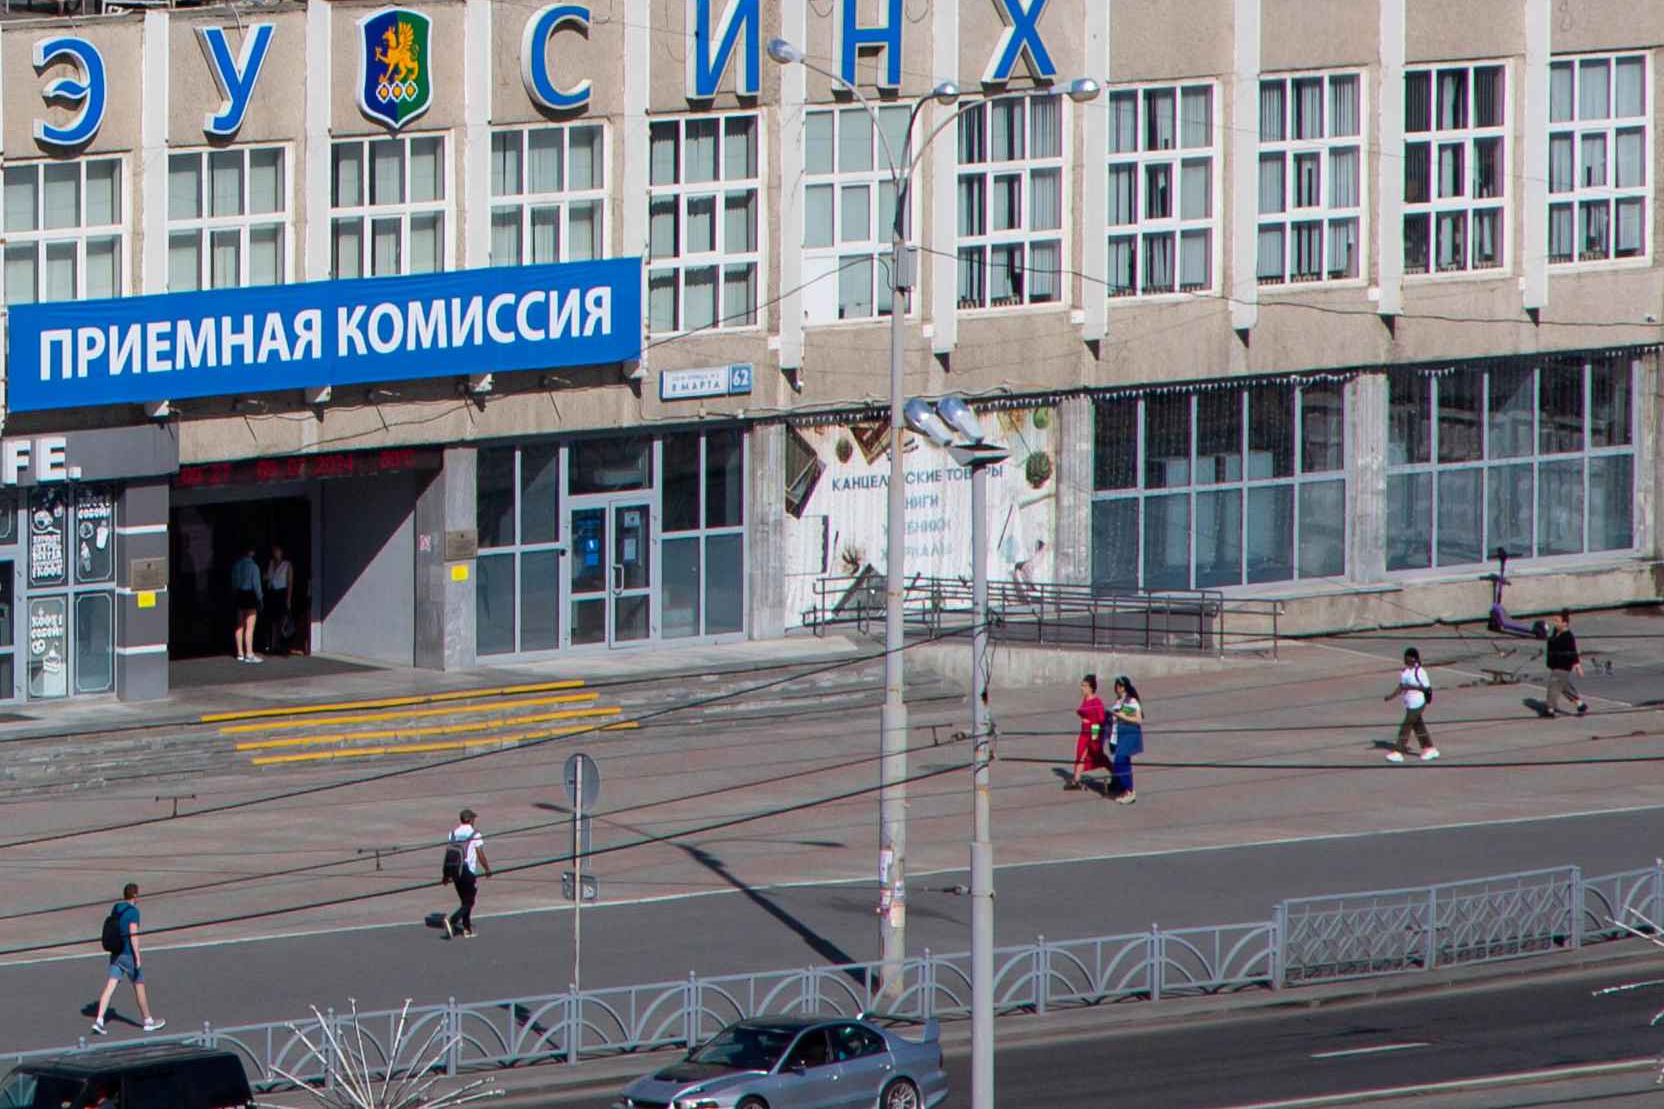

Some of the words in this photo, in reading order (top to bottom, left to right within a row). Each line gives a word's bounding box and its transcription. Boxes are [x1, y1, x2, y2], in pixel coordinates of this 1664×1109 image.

[39, 307, 324, 381] ПРИЕМНАЯ
[338, 285, 613, 359] КОМИССИЯ
[732, 368, 749, 387] 62
[832, 469, 943, 492] КАНЦЕЛСКИЕ
[902, 495, 939, 510] НИГИ
